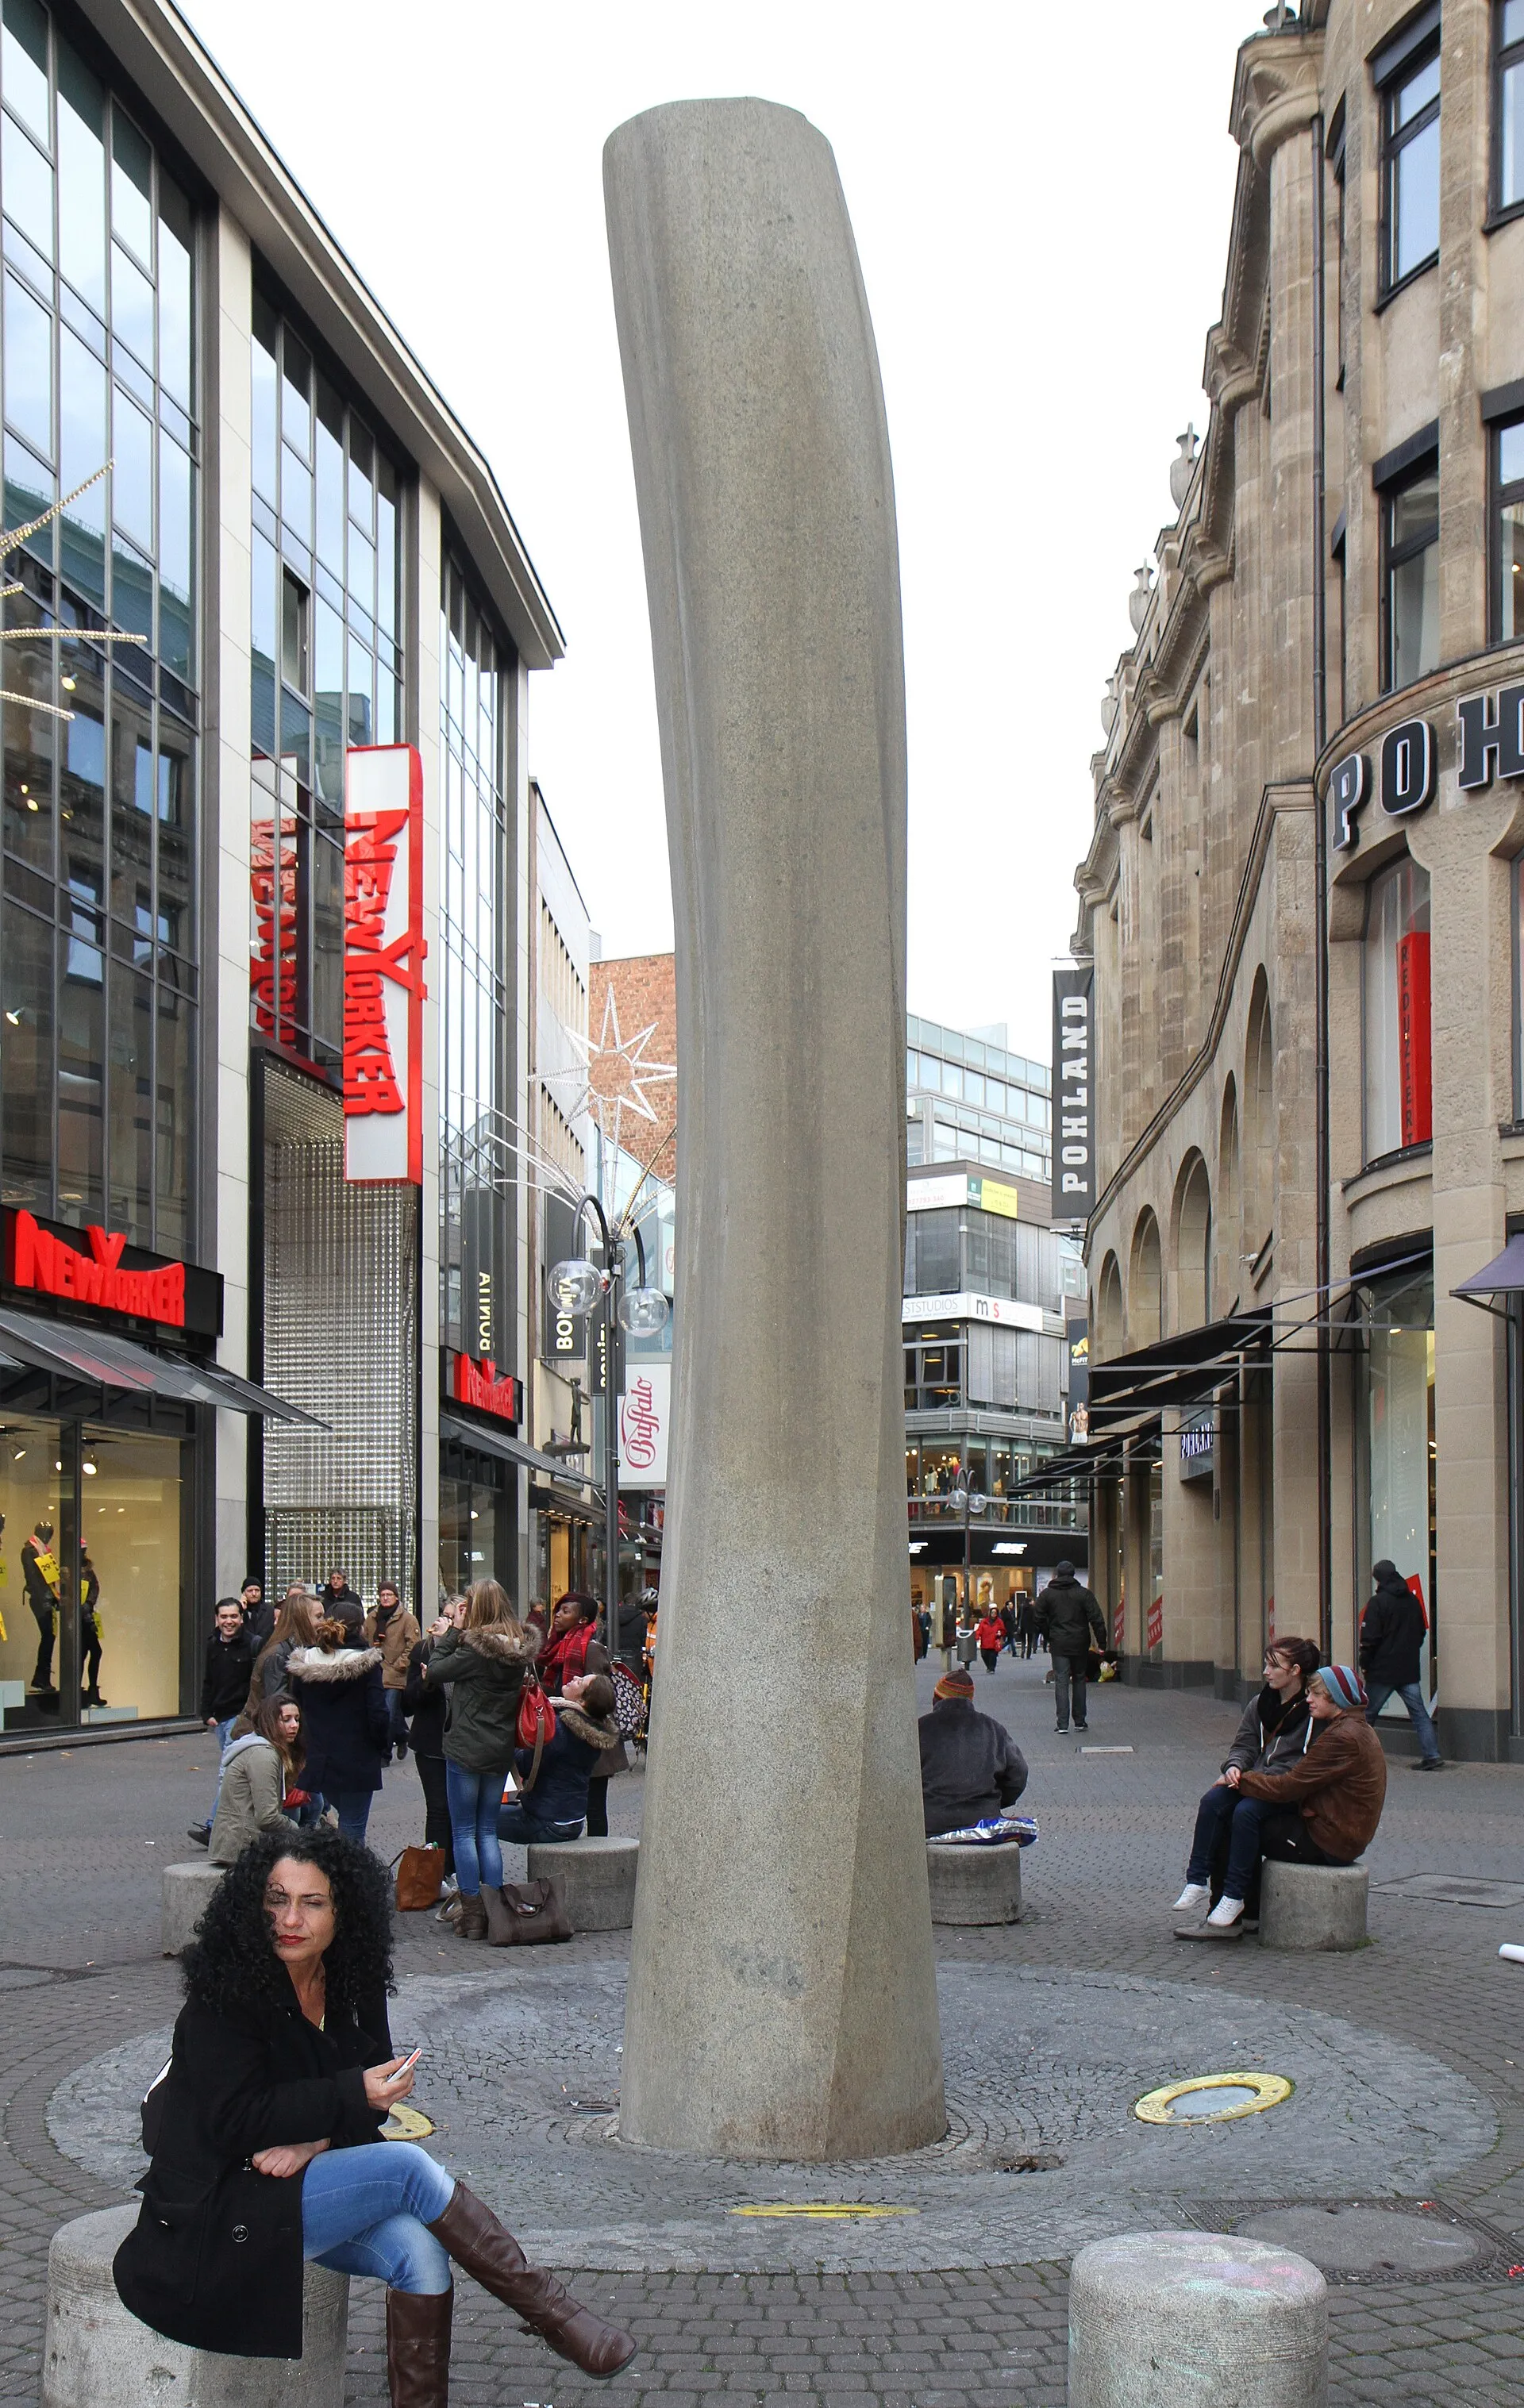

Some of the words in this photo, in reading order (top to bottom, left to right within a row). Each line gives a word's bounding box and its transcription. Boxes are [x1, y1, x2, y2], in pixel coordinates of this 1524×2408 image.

[1061, 996, 1088, 1193] POHLAND
[903, 1298, 958, 1314] STSTUDIOS
[621, 1376, 660, 1470] Buffalo
